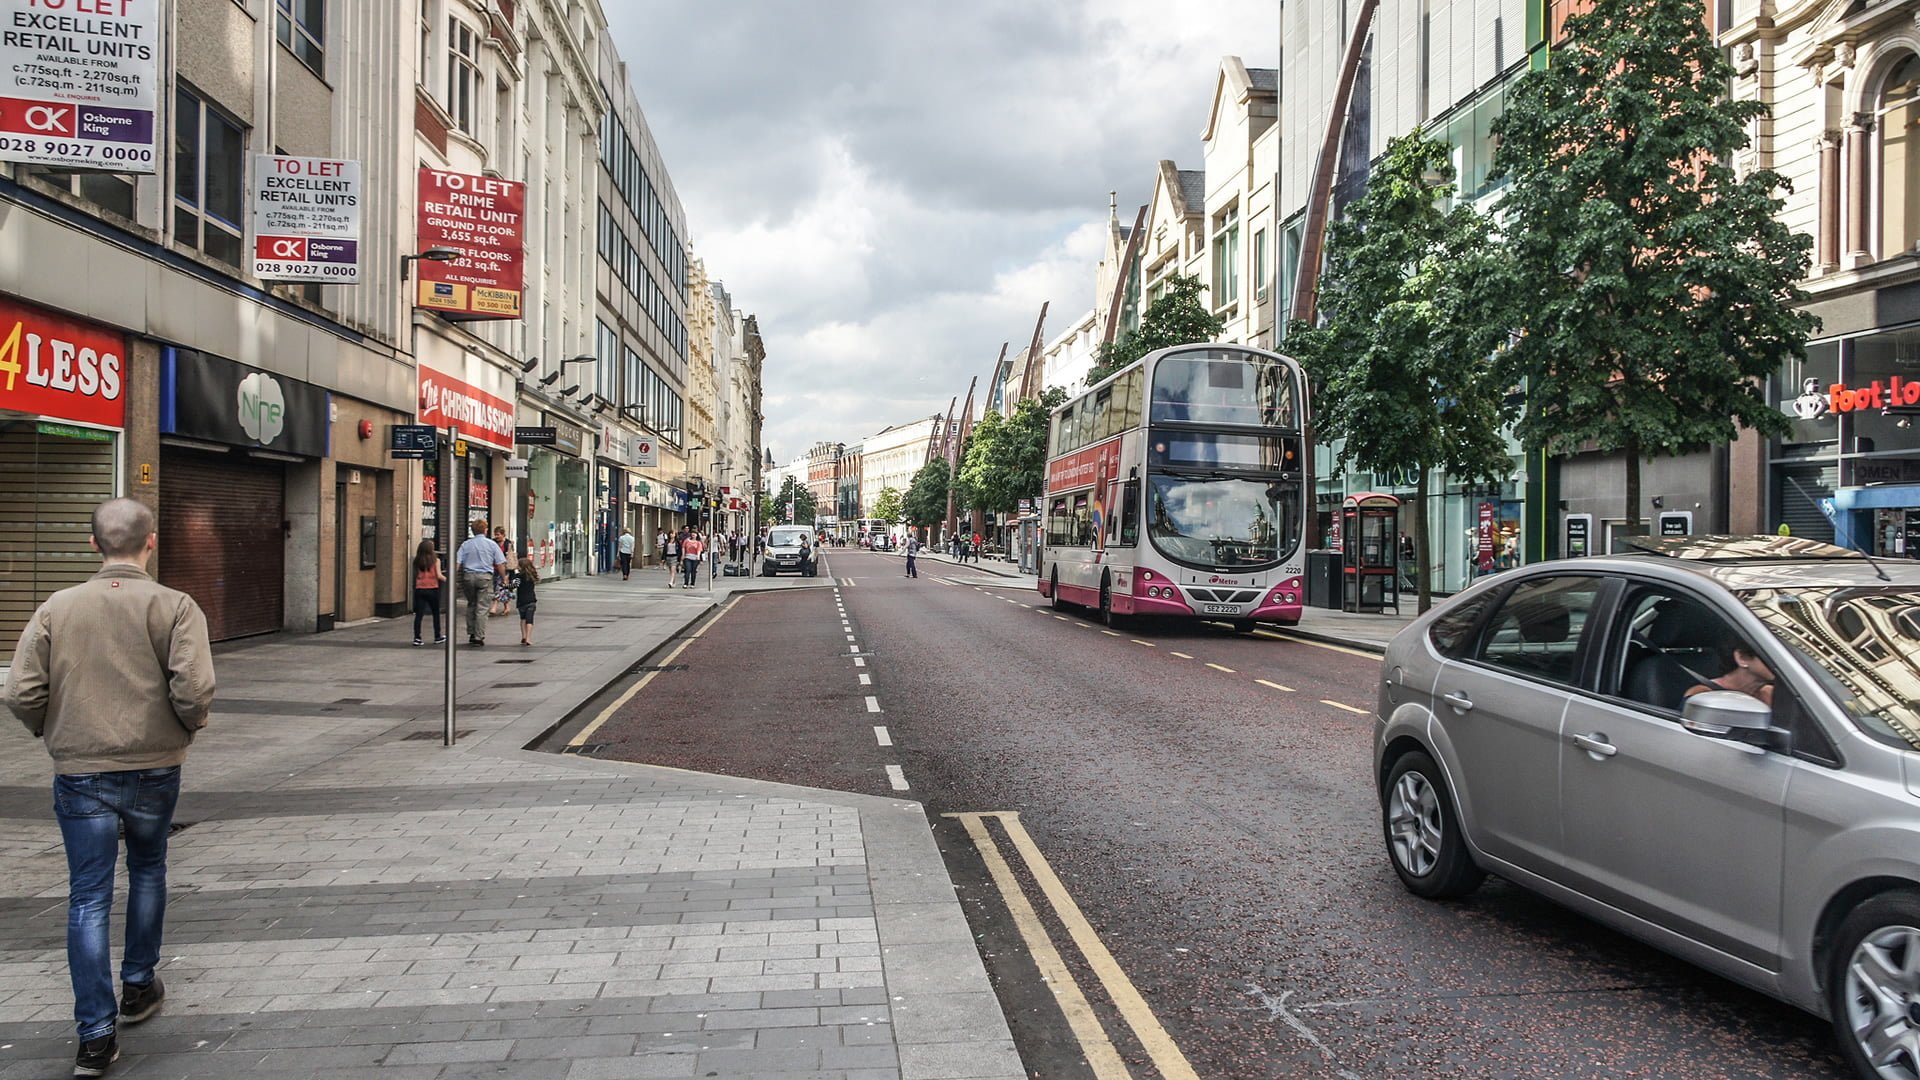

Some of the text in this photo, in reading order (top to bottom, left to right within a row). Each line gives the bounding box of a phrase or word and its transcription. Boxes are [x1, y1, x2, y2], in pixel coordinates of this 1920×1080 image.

[13, 11, 143, 39] EXCELLENT
[3, 31, 151, 60] RETAIL UNITS
[36, 54, 118, 68] AVAILABLE FROM
[13, 64, 72, 78] c.775sq.ft
[83, 70, 140, 84] 2,270sq.ft
[15, 76, 73, 90] (c.72sq.m
[85, 82, 138, 97] 211sq.m)
[67, 93, 101, 102] ENQUIRIES
[83, 113, 132, 125] Osborne
[83, 123, 109, 136] King
[0, 137, 151, 161] 028 9027 0000
[273, 159, 344, 177] TO LET
[266, 177, 351, 192] EXCELLENT
[431, 171, 513, 197] TO LET
[260, 190, 356, 206] RETAIL UNITS
[450, 192, 494, 209] PRIME
[425, 201, 518, 224] RETAIL UNIT
[427, 217, 515, 236] GROUND FLOOR:
[441, 229, 500, 246] 3,655 sq.ft.
[311, 243, 343, 251] Osborne
[311, 250, 328, 259] King
[468, 249, 512, 262] FLOORS:
[256, 263, 356, 276] 028 9027 0000
[475, 261, 501, 272] sq.ft.
[460, 276, 497, 285] ENQUIRIES
[421, 379, 438, 408] The
[1829, 380, 1884, 415] Foot
[242, 391, 281, 423] Nine
